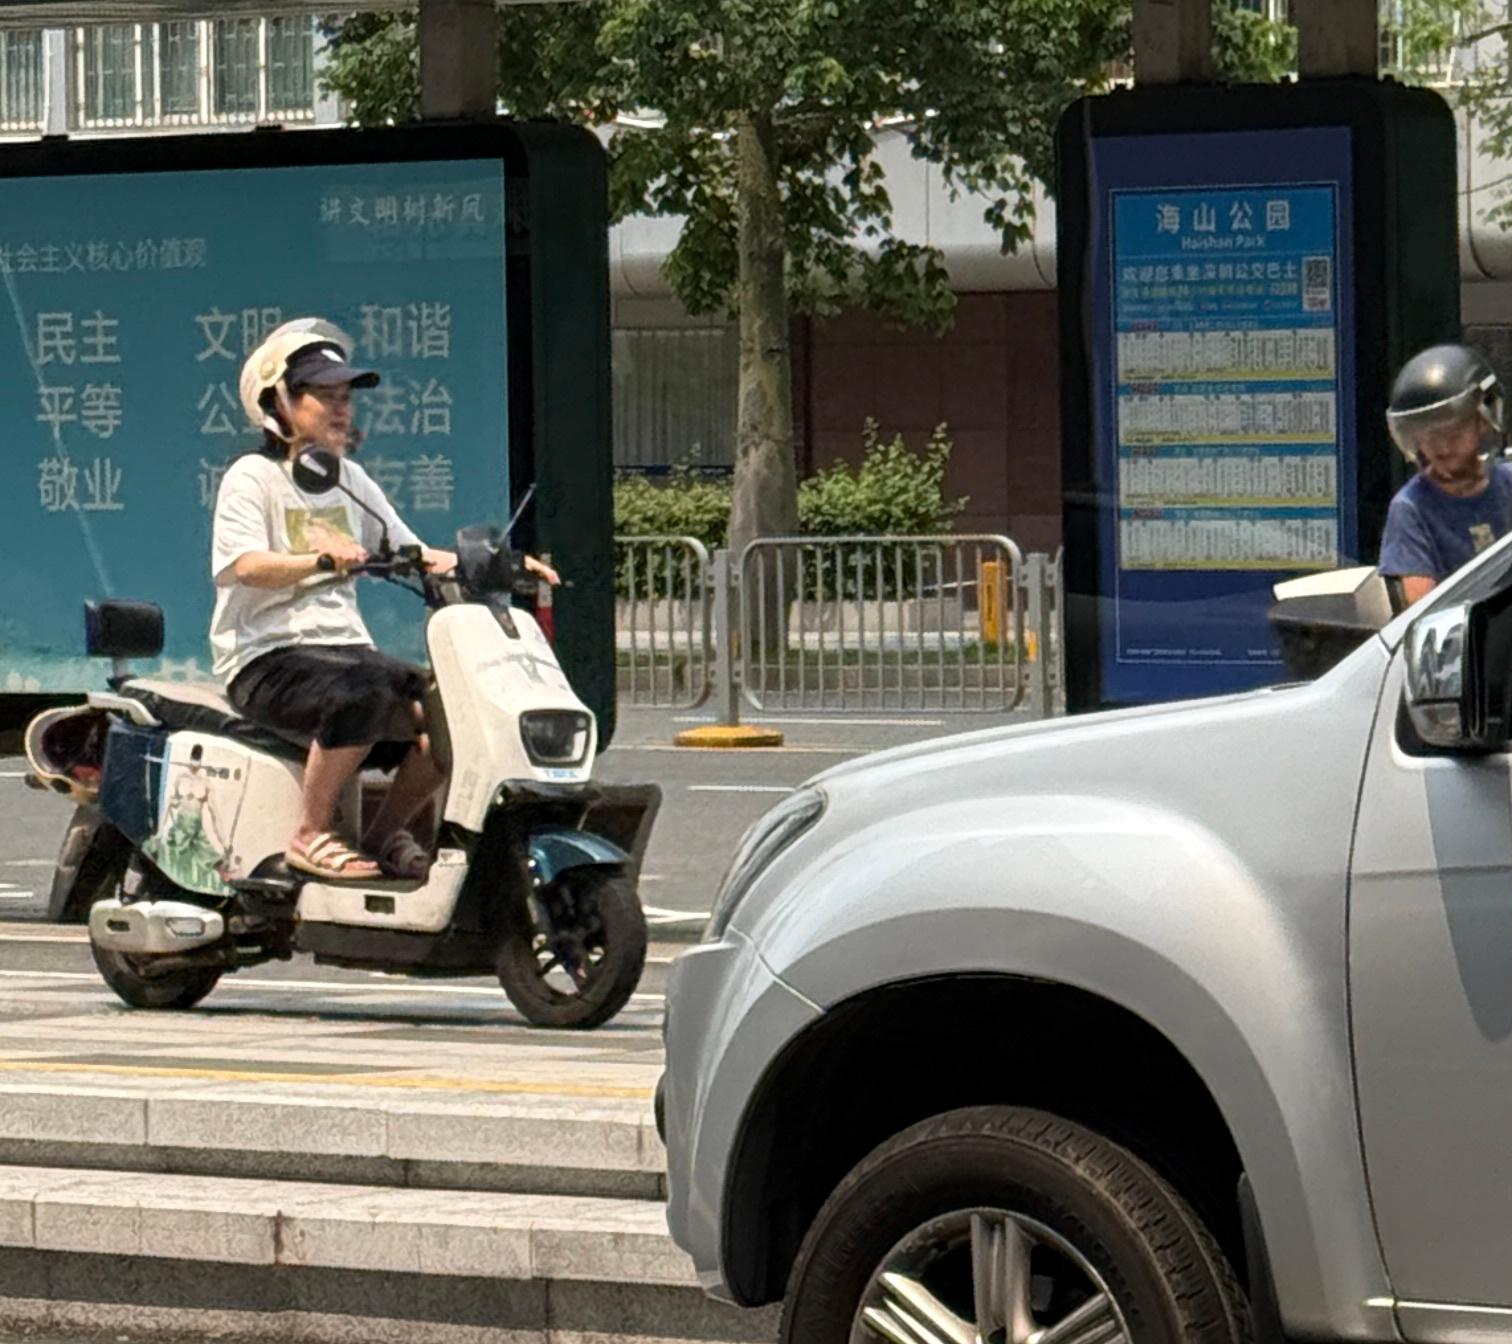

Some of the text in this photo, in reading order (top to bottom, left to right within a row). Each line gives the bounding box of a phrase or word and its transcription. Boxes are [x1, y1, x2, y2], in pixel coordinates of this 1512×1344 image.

[319, 192, 486, 225] 讲文明树新风
[1156, 199, 1291, 235] 海山公园
[1181, 233, 1266, 251] Haishan Park
[36, 310, 121, 365] 民主
[359, 304, 451, 359] 和谐
[36, 383, 123, 440] 平等
[358, 373, 453, 436] 法治
[37, 457, 125, 513] 敬业
